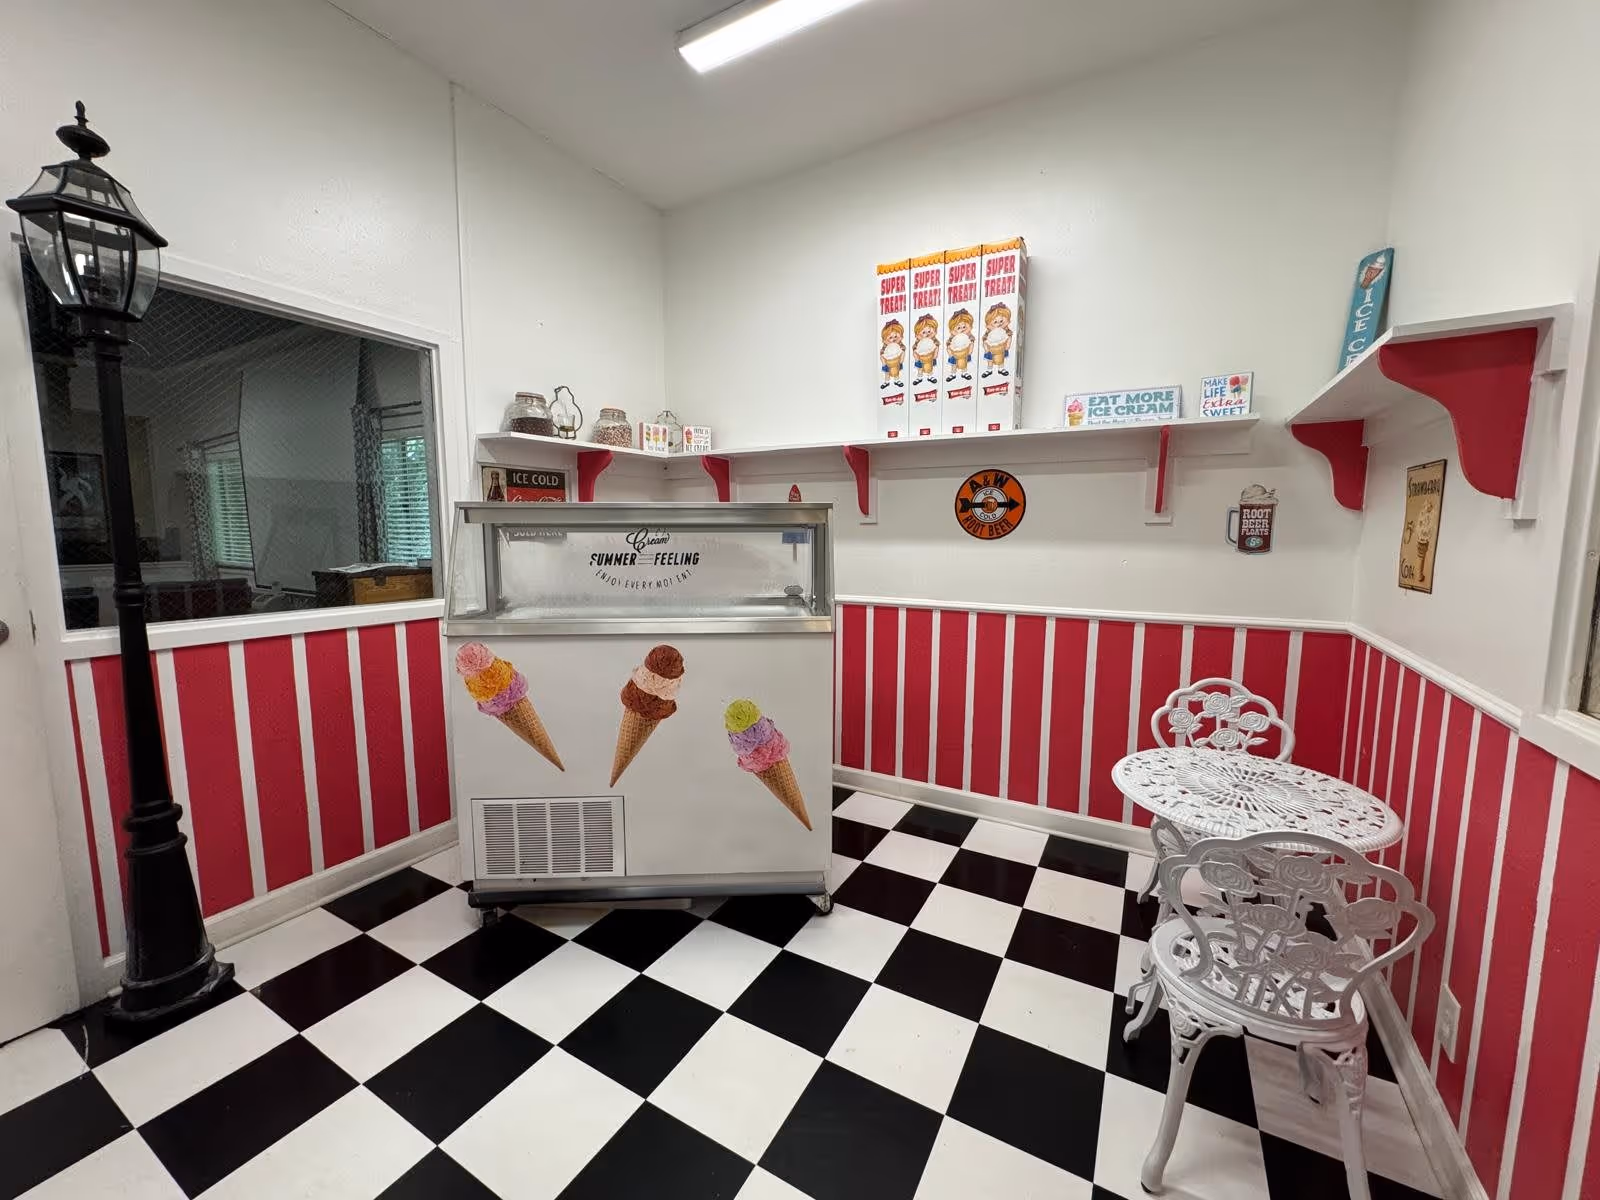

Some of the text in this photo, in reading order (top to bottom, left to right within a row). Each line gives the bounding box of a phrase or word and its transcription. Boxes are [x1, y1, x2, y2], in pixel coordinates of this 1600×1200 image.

[949, 262, 976, 284] SUPER
[986, 255, 1015, 277] SUPER
[881, 275, 906, 295] SUPER
[914, 269, 940, 289] SUPER
[984, 275, 1016, 297] TREAT!
[913, 288, 941, 309] TREAT!
[948, 282, 977, 304] TREAT!
[880, 294, 906, 315] TREAT!
[1353, 287, 1374, 333] ICE
[1204, 378, 1227, 387] MAKE
[1088, 391, 1174, 406] EAT MORE
[1204, 386, 1226, 398] LIFE
[1088, 402, 1174, 417] ICE CREAM
[512, 472, 559, 486] ICE COLD
[969, 479, 982, 494] A
[1243, 508, 1271, 518] ROOT
[962, 515, 1013, 537] ROOT BEER
[1241, 528, 1270, 536] FLOATS
[1242, 519, 1269, 528] BEER
[626, 528, 671, 553] Cream
[590, 552, 700, 566] SUMMER FEELING
[624, 580, 652, 590] EVERY
